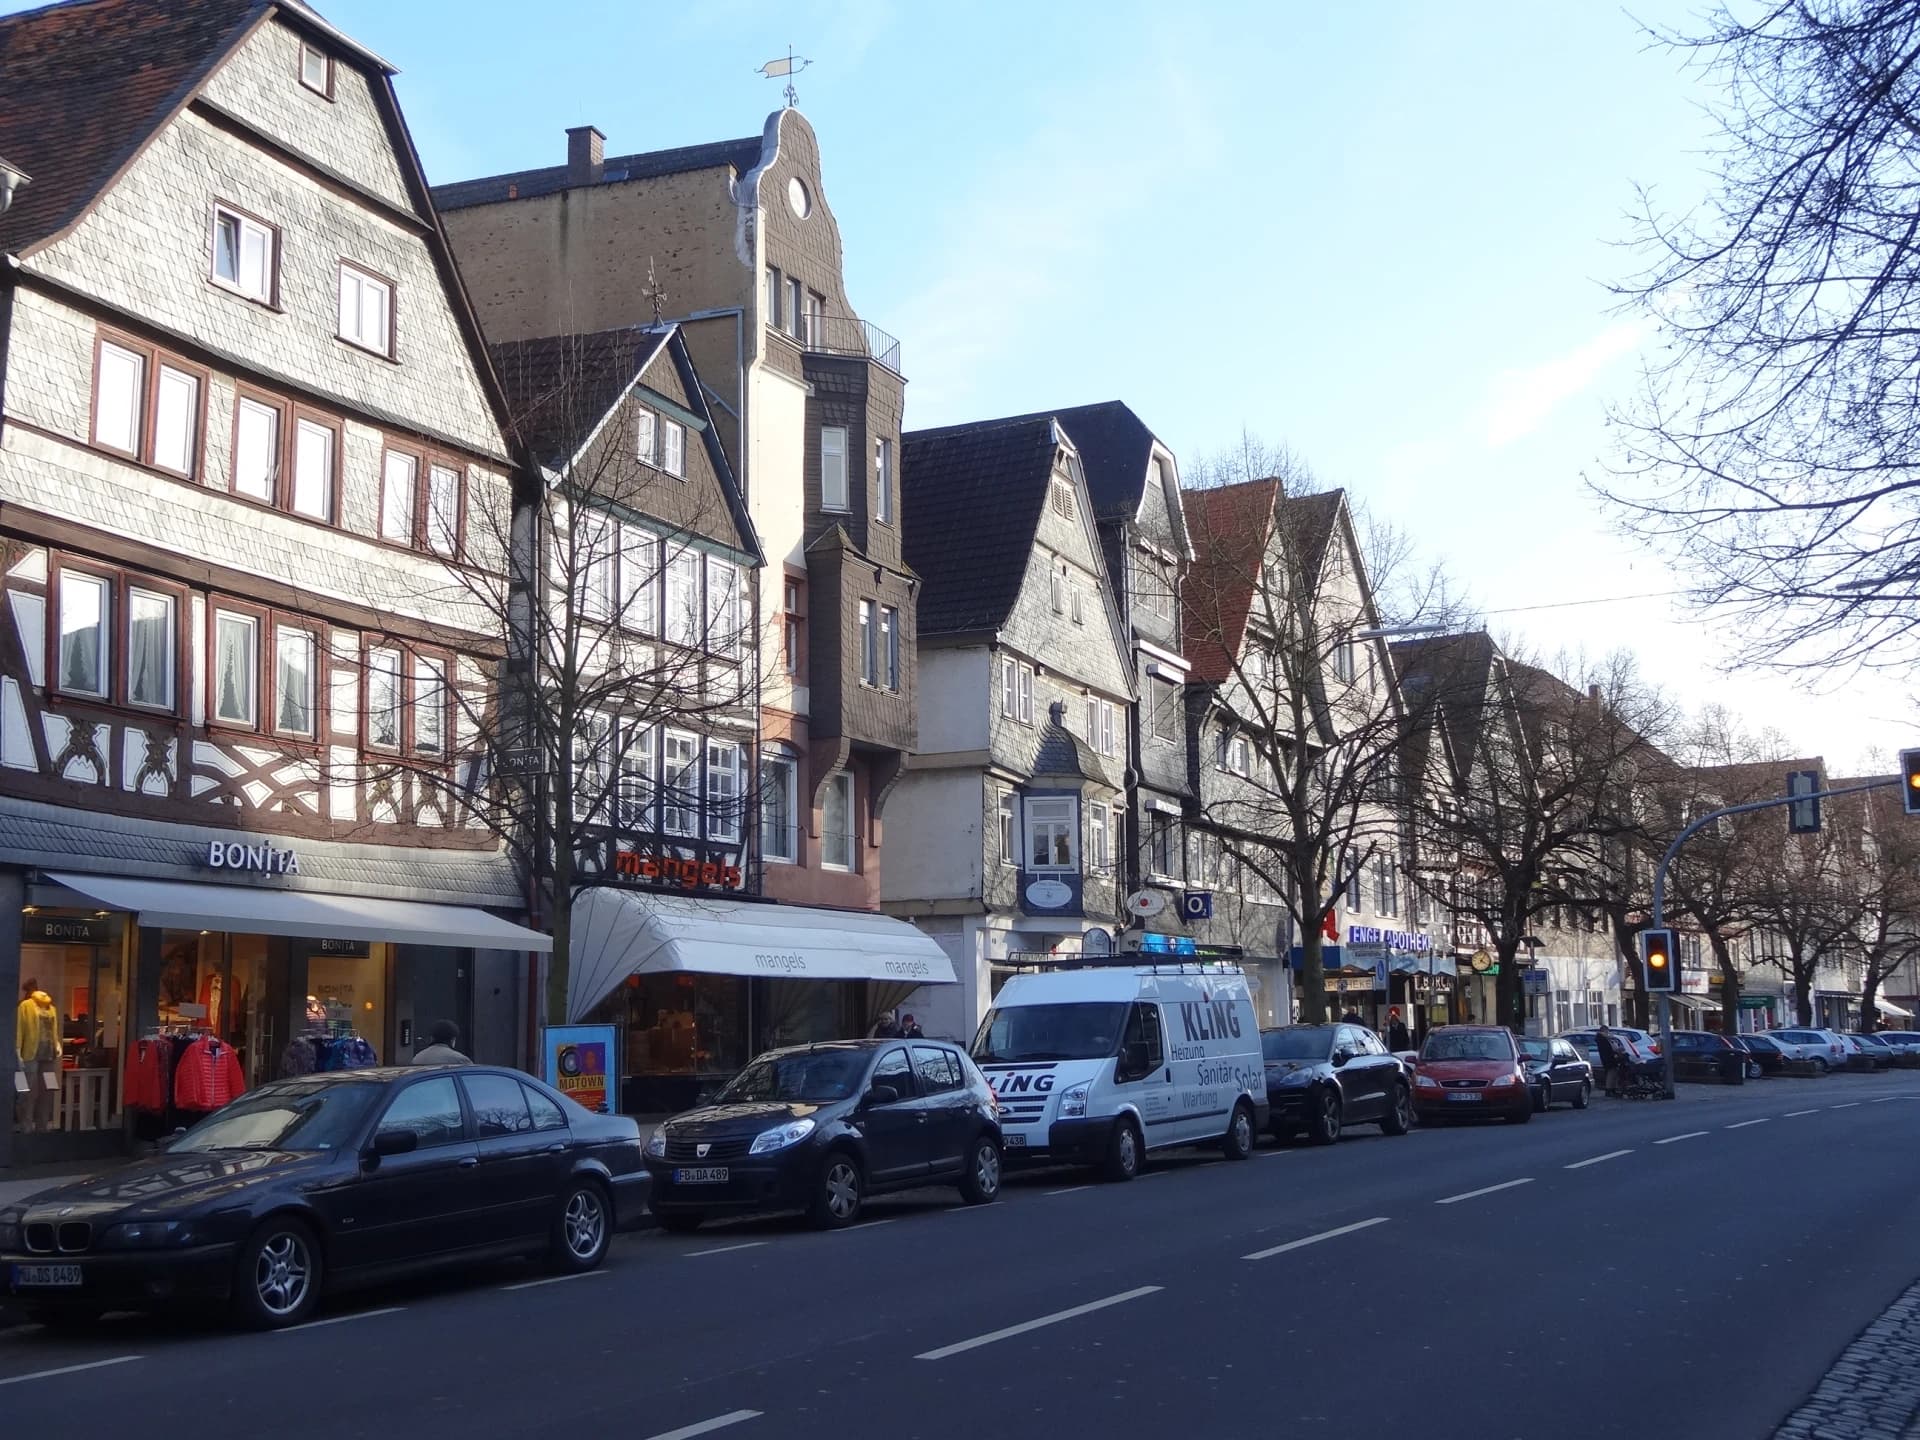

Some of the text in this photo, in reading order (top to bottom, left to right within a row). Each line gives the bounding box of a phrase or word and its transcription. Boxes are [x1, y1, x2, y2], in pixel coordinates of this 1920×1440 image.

[209, 840, 300, 879] BONITA
[616, 850, 741, 889] mangels
[45, 922, 90, 939] BONITA
[755, 951, 806, 972] mangels
[885, 960, 929, 977] mangels
[1170, 1043, 1206, 1062] Heizung
[559, 1077, 604, 1089] MOTOWN
[1197, 1062, 1233, 1086] Sanitär
[1235, 1064, 1262, 1092] Solar
[1181, 1091, 1218, 1109] Wartung
